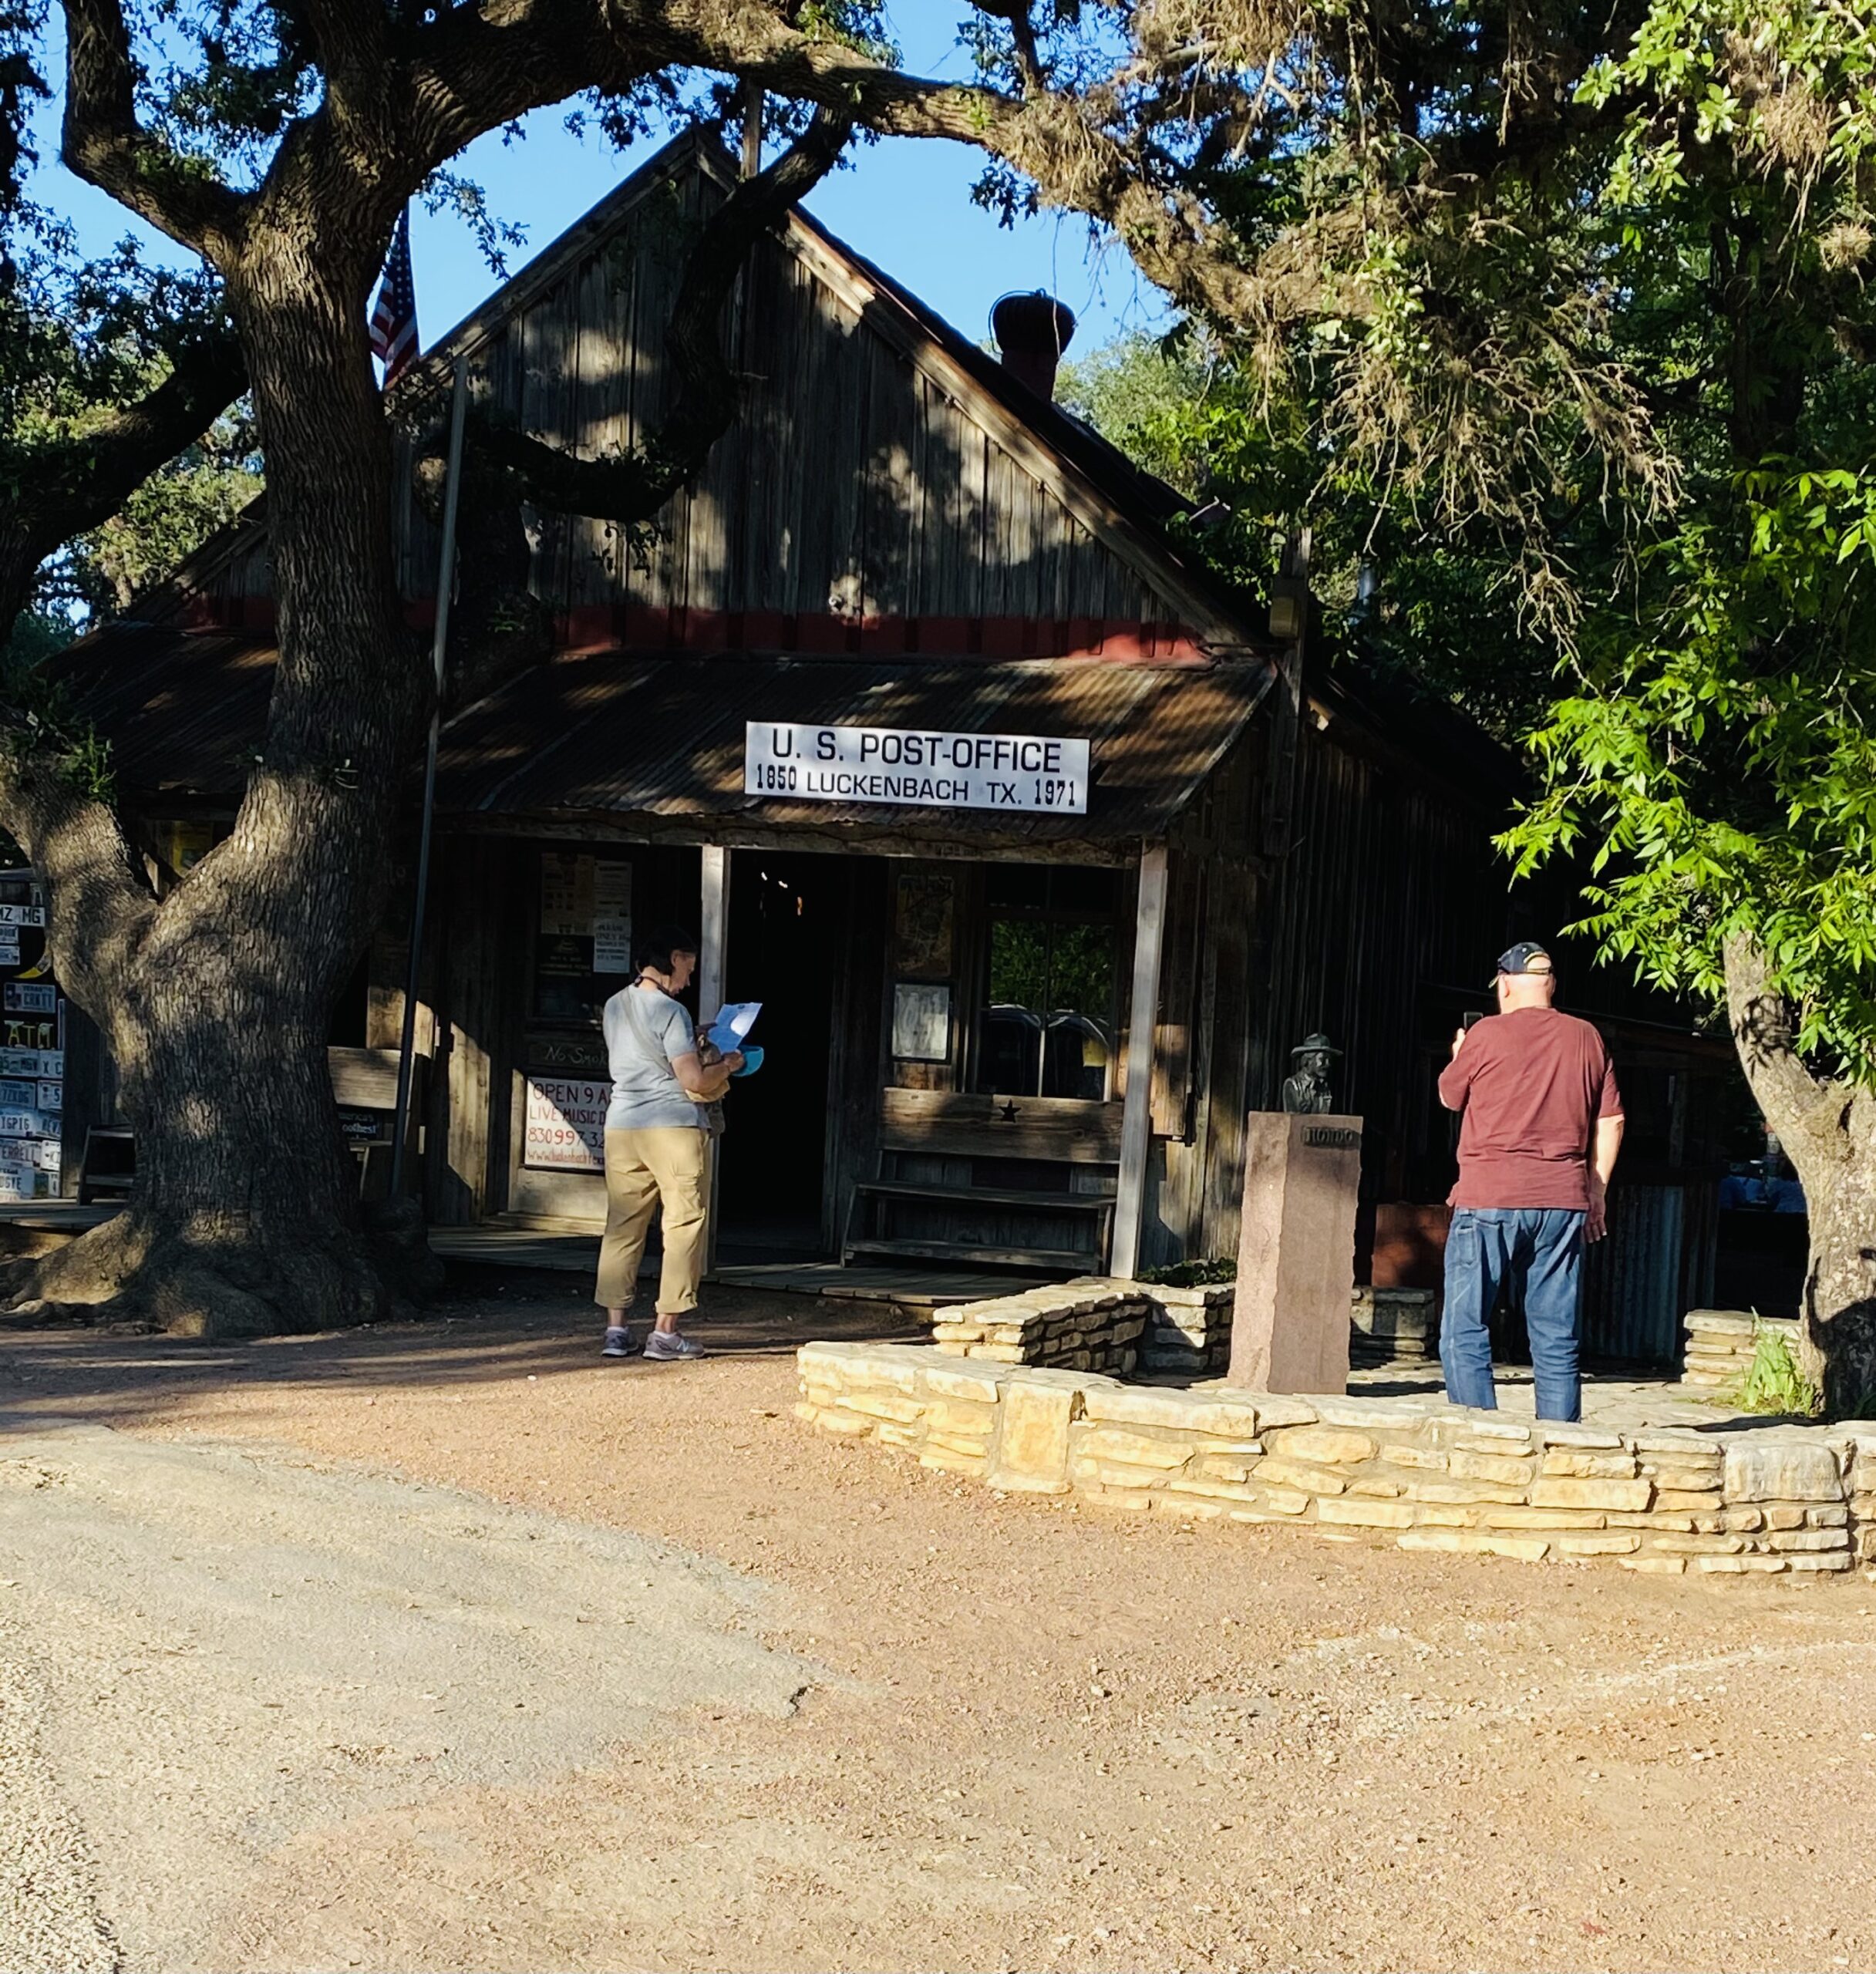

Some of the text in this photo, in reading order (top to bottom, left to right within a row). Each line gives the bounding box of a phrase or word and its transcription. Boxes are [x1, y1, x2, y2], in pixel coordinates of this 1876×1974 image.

[772, 728, 1062, 773] U. S. POST-OFFICE
[756, 763, 1076, 807] 1850 LUCKENBACH TX. 1971
[544, 1045, 566, 1062] No
[533, 1083, 578, 1105] OPEN
[584, 1086, 594, 1104] 9
[528, 1104, 558, 1122] LIVE
[563, 1107, 597, 1125] MUSIC
